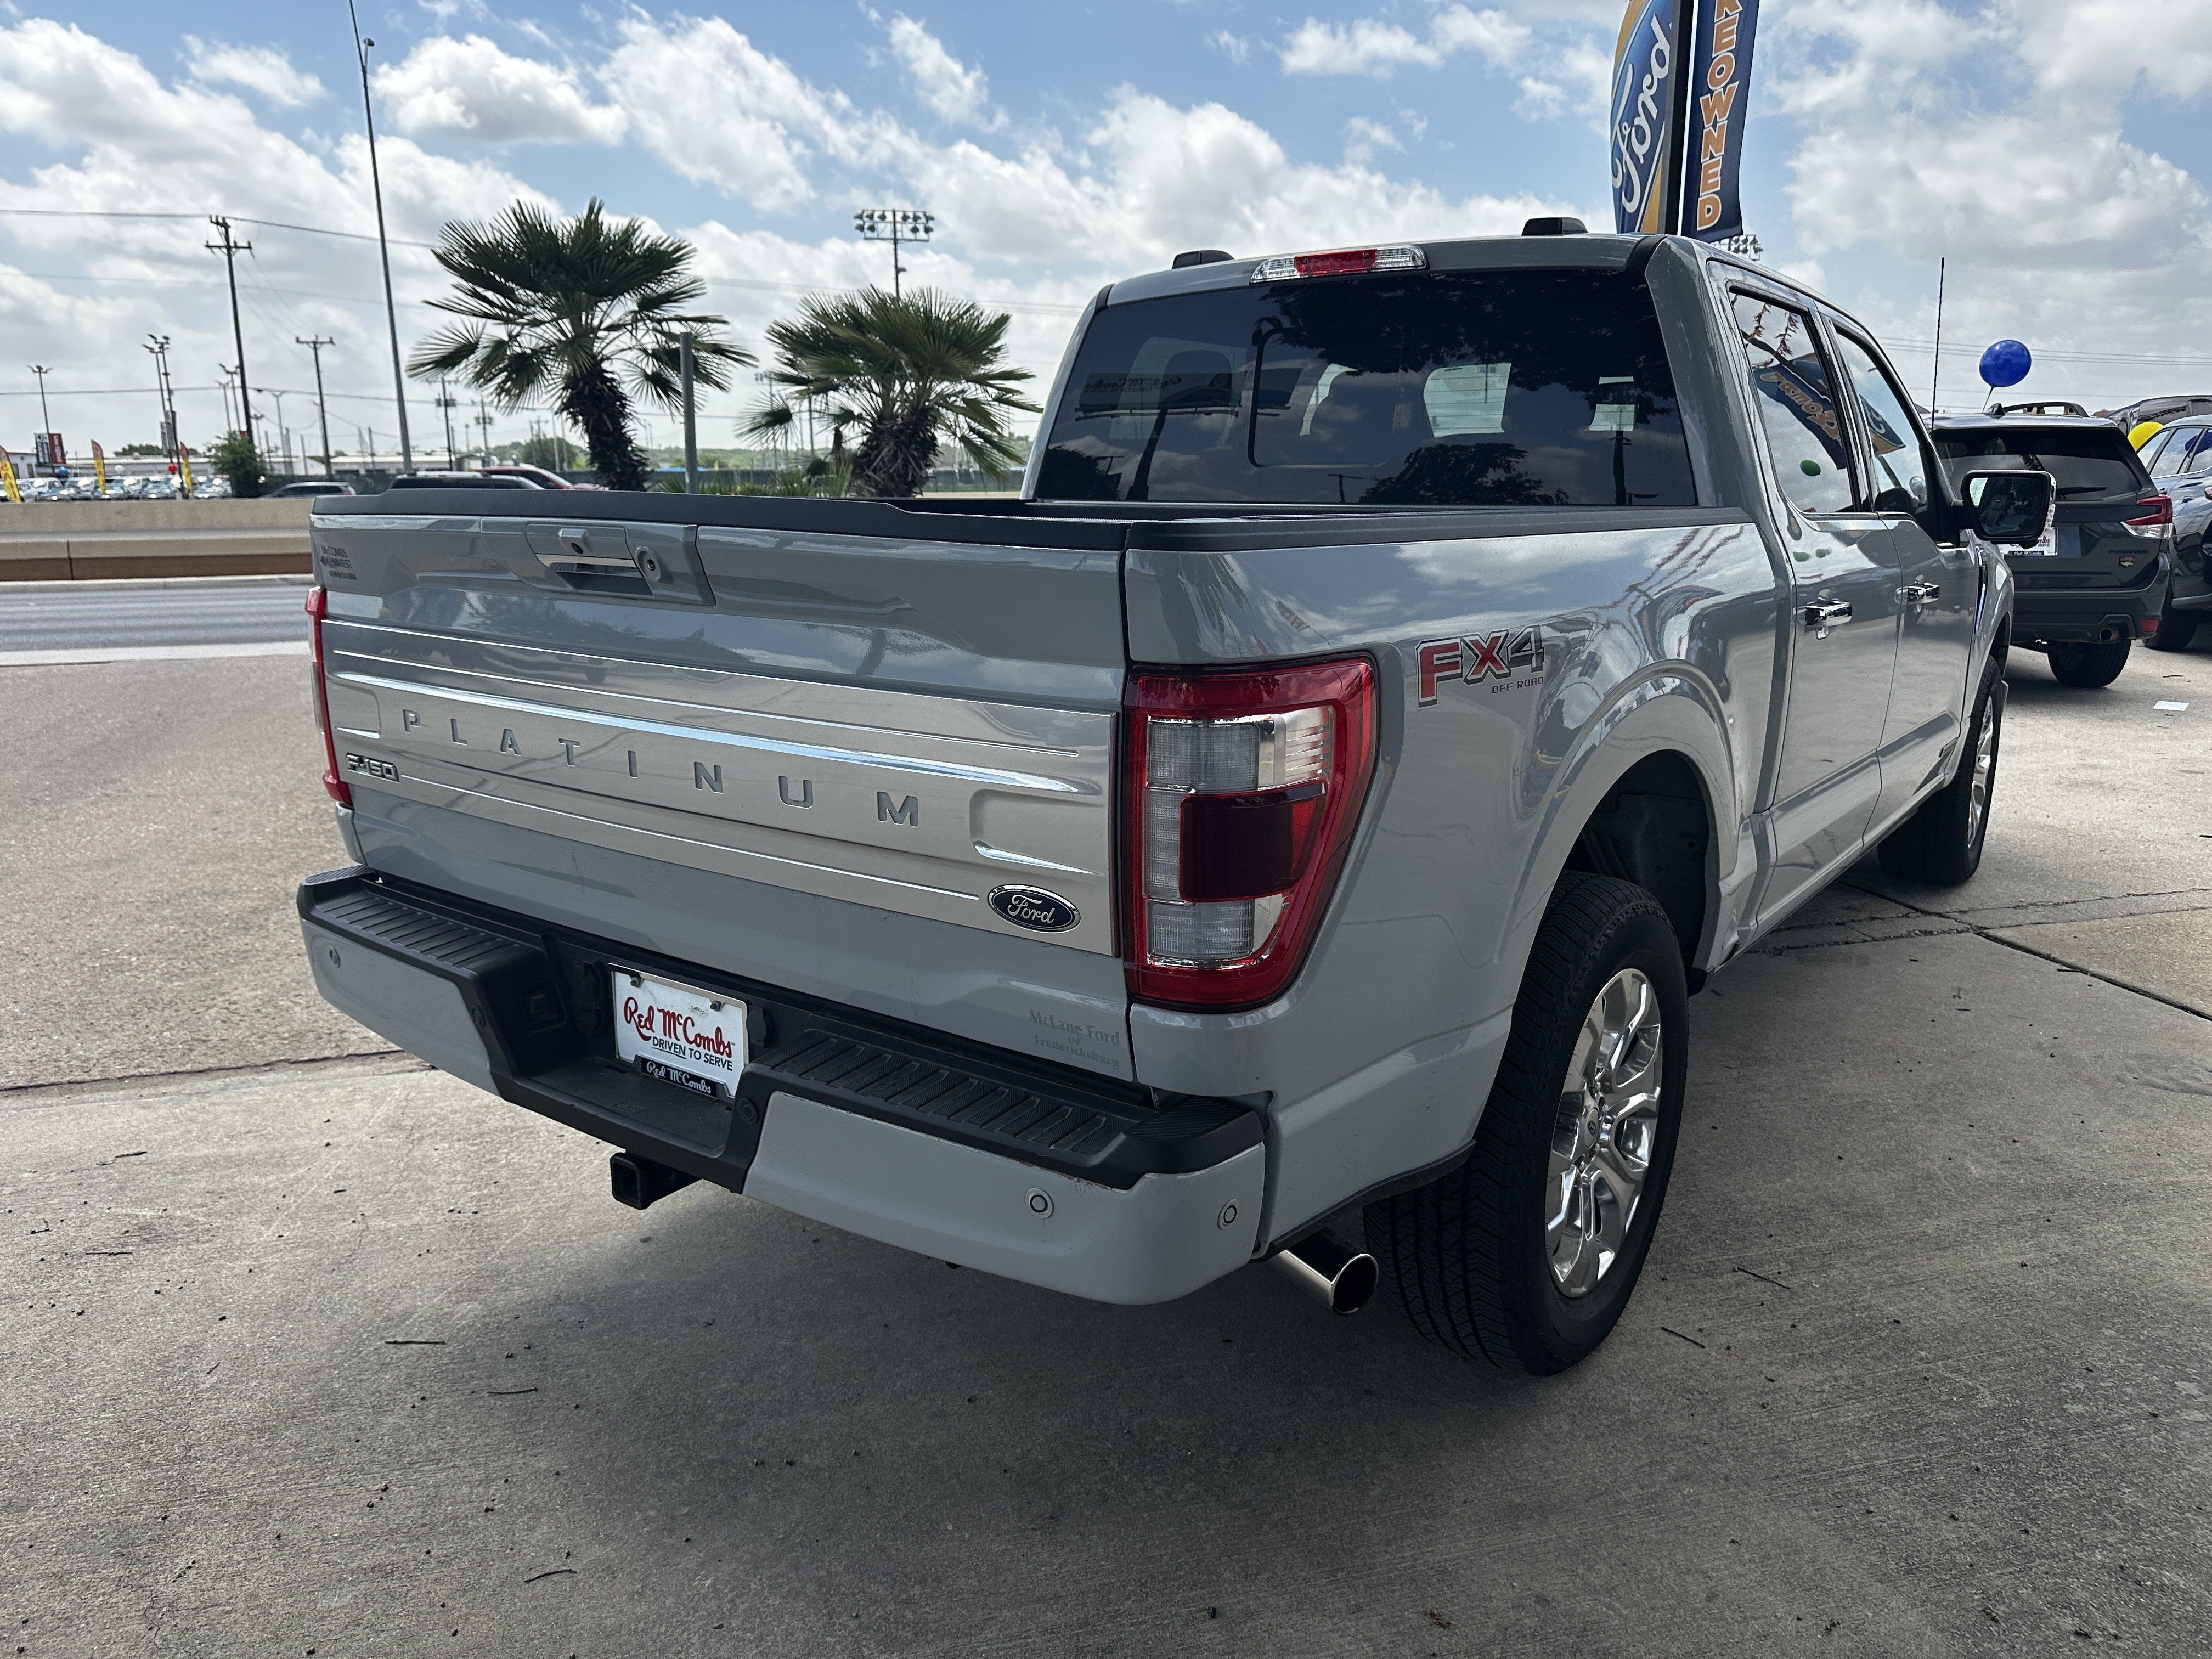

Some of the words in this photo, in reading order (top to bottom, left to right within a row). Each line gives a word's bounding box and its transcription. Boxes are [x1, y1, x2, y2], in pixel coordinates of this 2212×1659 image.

[1612, 14, 1671, 214] Ford
[1415, 624, 1545, 709] FX4
[1492, 682, 1513, 694] OFF
[1517, 676, 1544, 689] ROAD
[346, 752, 399, 783] F-150
[403, 709, 920, 827] PLATINUM
[1007, 894, 1056, 924] Ford
[624, 996, 656, 1041] Red
[657, 1006, 732, 1058] McCombs
[1029, 1009, 1082, 1036] McLane
[1086, 1024, 1120, 1047] Ford
[652, 1036, 686, 1056] DRIVEN
[688, 1048, 702, 1060] TO
[704, 1053, 733, 1071] SERVE
[646, 1061, 666, 1079] Red
[666, 1068, 711, 1094] McCombs
